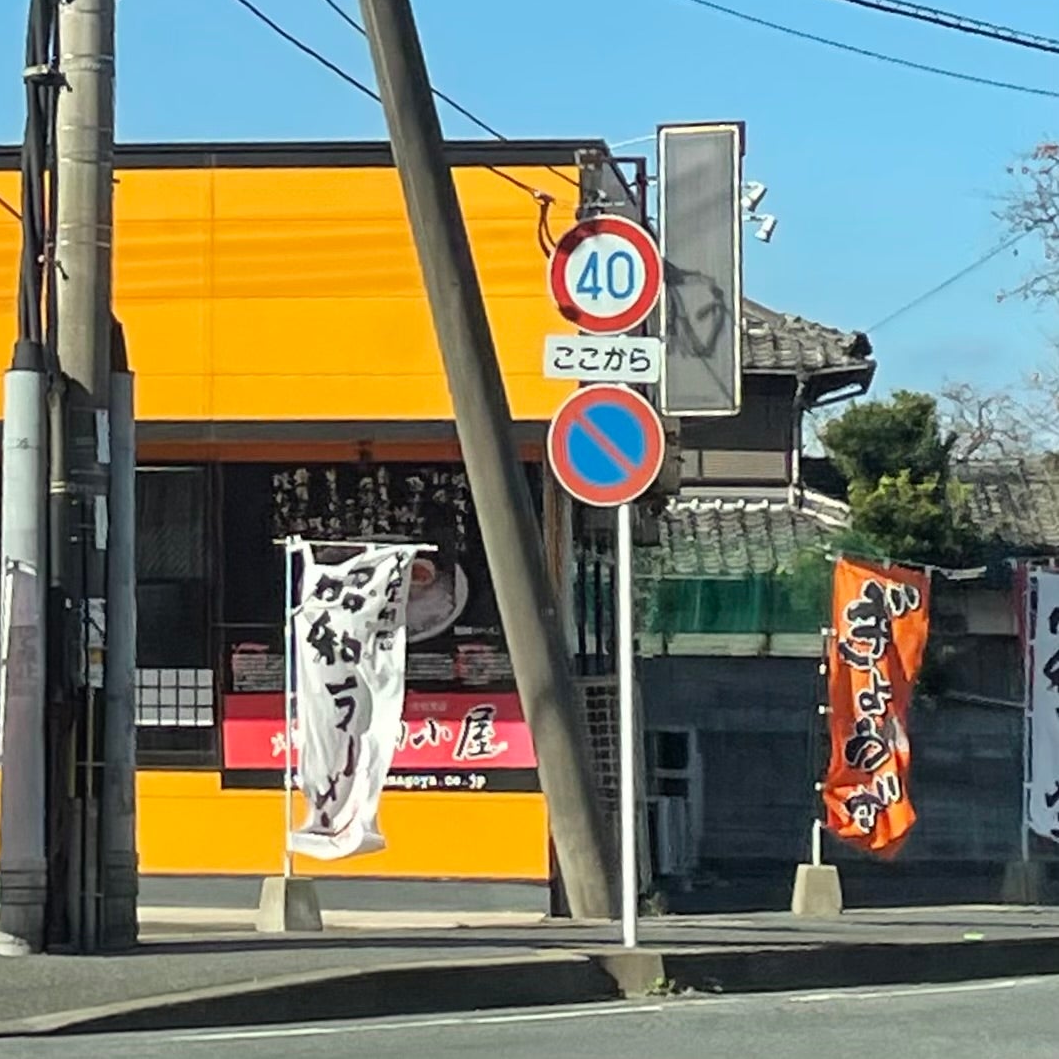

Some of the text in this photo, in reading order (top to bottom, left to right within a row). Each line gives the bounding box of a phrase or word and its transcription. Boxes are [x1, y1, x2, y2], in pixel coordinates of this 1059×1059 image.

[576, 250, 635, 301] 40
[552, 346, 652, 373] ここから
